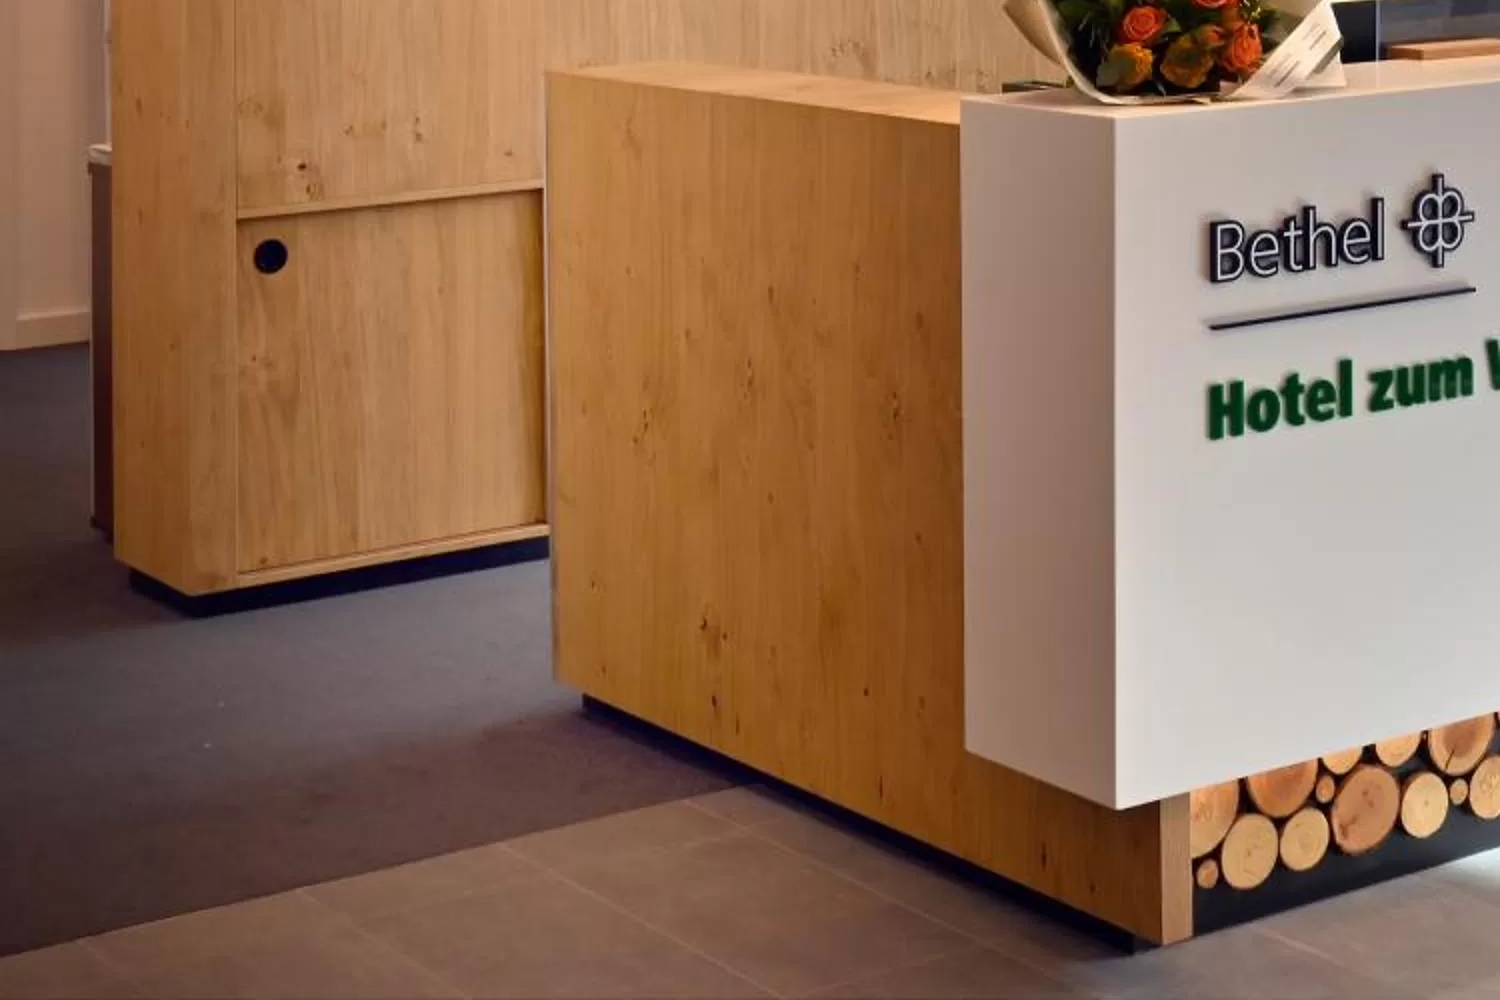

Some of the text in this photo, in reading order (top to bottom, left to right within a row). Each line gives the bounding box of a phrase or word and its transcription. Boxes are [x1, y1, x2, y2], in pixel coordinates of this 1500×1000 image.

[1209, 197, 1384, 283] Bethel
[1207, 359, 1353, 441] Hotel
[1366, 356, 1474, 413] zum
